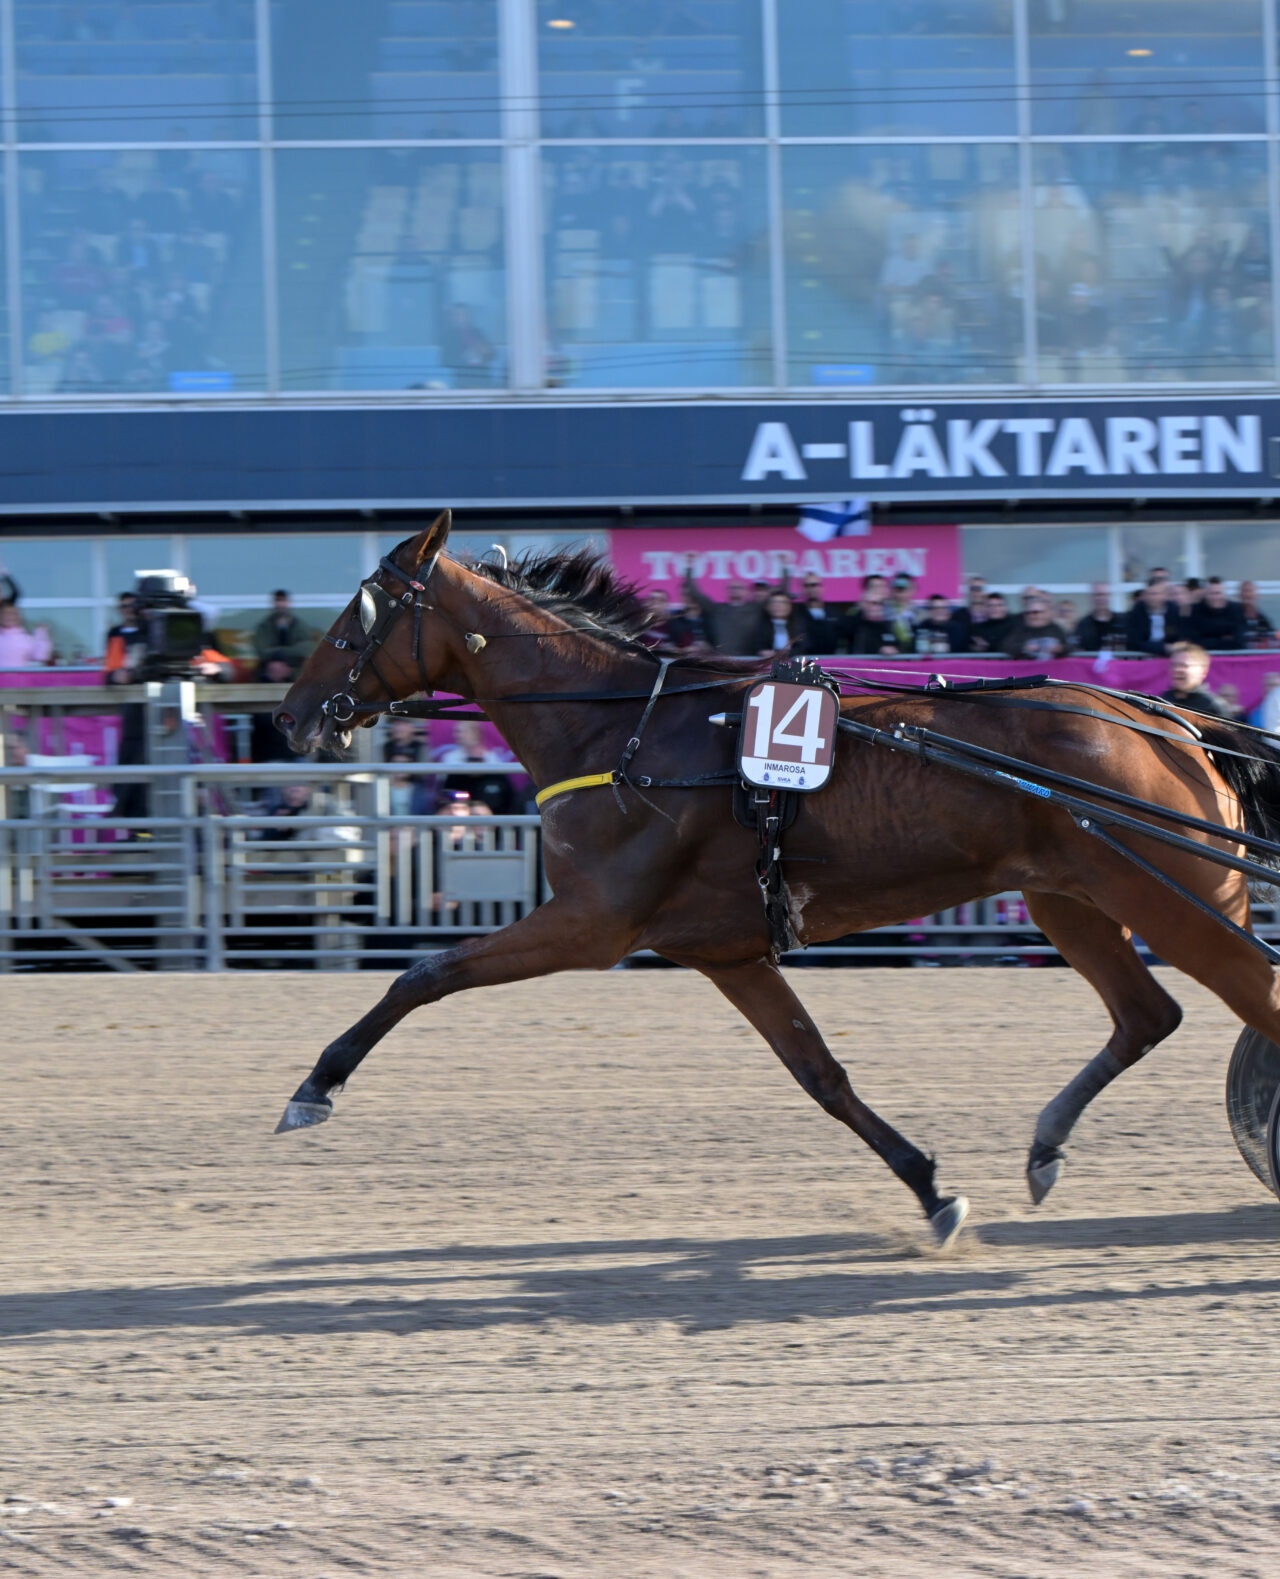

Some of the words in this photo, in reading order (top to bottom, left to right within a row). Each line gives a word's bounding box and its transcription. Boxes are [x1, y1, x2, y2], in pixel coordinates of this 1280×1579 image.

[741, 408, 1262, 481] A-LÄKTAREN
[641, 548, 927, 580] TOTOBAREN
[749, 684, 826, 764] 14
[764, 761, 806, 774] INMAROSA
